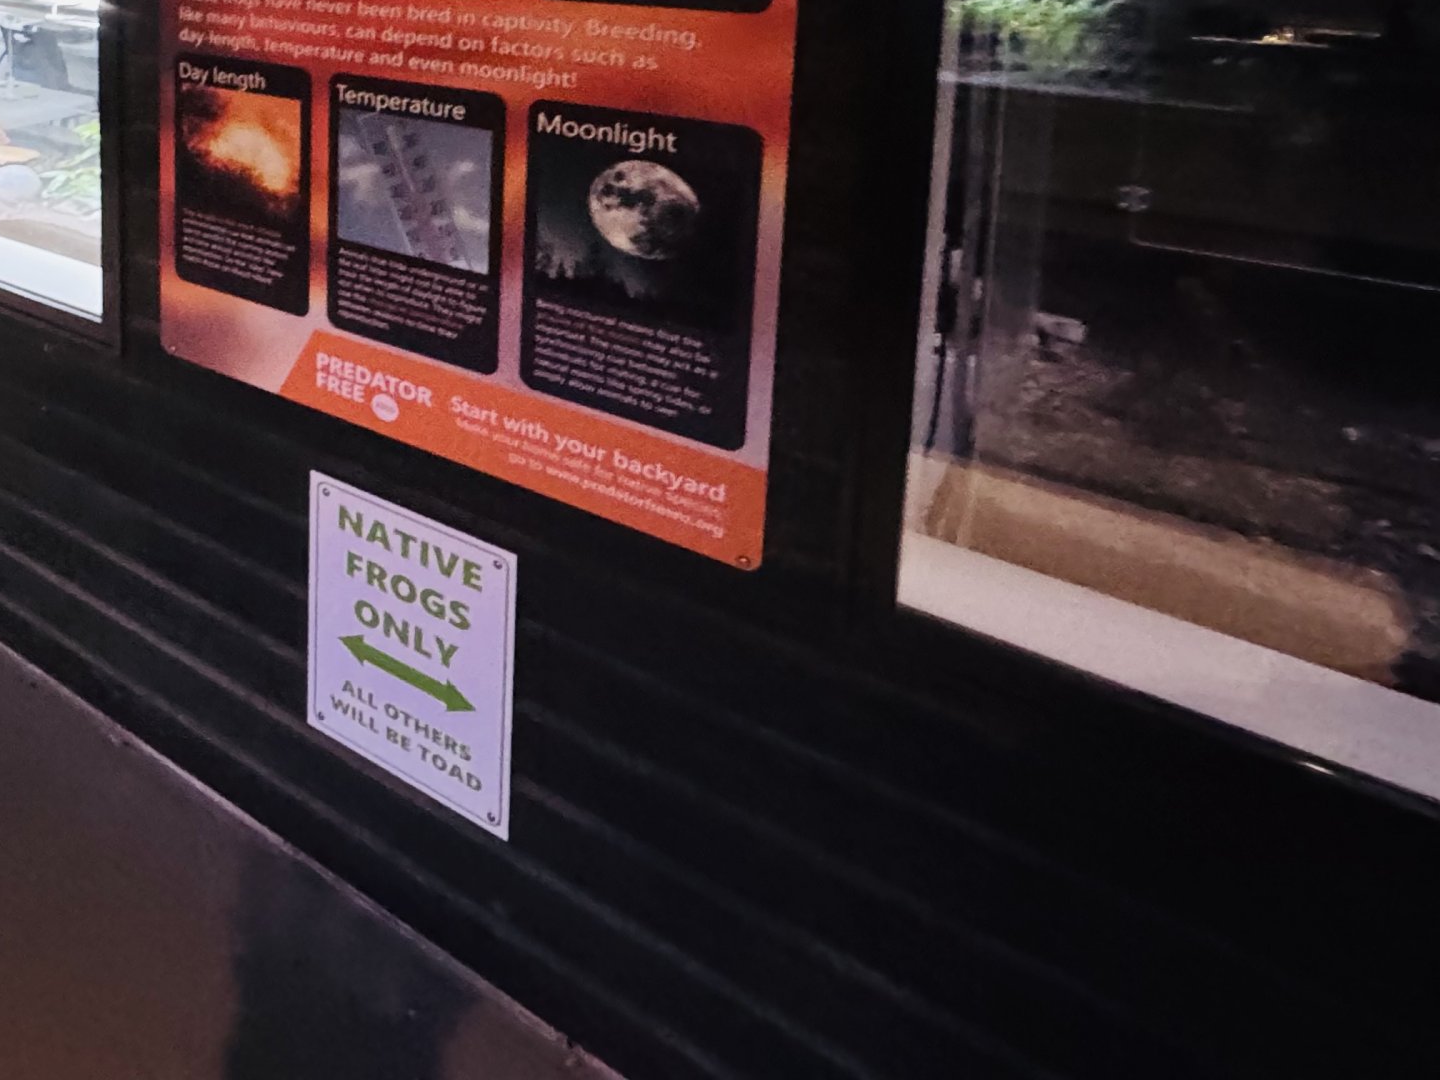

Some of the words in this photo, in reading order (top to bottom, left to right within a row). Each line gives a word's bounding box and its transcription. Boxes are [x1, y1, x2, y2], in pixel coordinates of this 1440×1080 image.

[179, 6, 203, 22] like
[206, 12, 246, 30] many
[345, 27, 376, 41] can
[381, 27, 452, 49] depend
[459, 37, 484, 51] on
[491, 37, 564, 60] factors
[572, 48, 624, 67] such
[632, 56, 658, 71] as
[305, 0, 351, 15] never
[357, 2, 401, 17] been
[407, 5, 451, 22] bred
[457, 13, 475, 26] in
[179, 62, 209, 84] Day
[213, 67, 267, 91] length
[265, 39, 364, 63] temperature
[369, 52, 403, 67] and
[408, 57, 453, 73] even
[460, 63, 577, 90] moonlight!
[337, 83, 466, 121] Temperature
[536, 112, 677, 153] Moonlight
[316, 352, 432, 408] PREDATOR
[316, 371, 365, 403] FREE
[450, 395, 499, 427] Start
[502, 415, 549, 443] with
[554, 434, 608, 462] your
[613, 449, 727, 503] backyard
[339, 504, 483, 592] NATIVE
[346, 550, 471, 631] FROGS
[354, 600, 459, 668] ONLY
[331, 695, 380, 734] WILL
[386, 726, 412, 752] BE
[417, 743, 483, 793] TOAD
[341, 680, 379, 710] ALL
[385, 703, 473, 761] OTHERS
